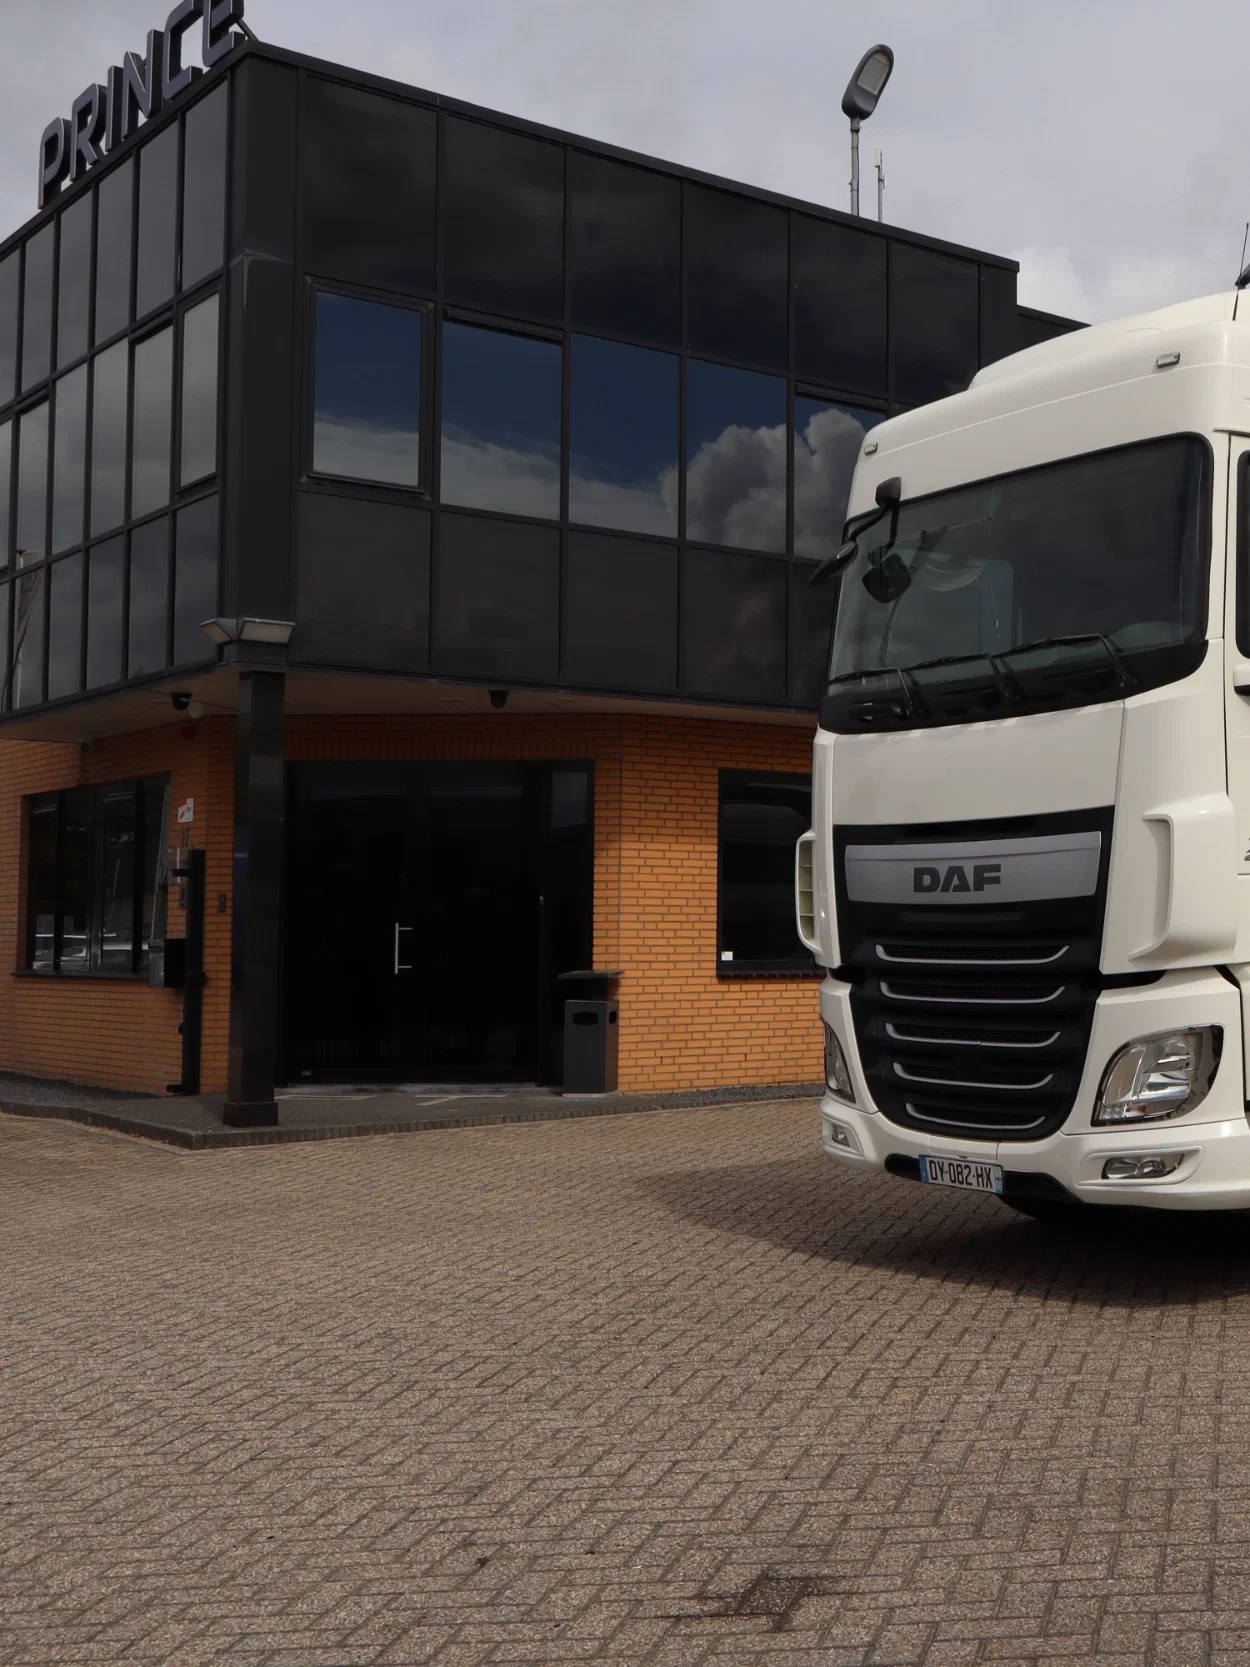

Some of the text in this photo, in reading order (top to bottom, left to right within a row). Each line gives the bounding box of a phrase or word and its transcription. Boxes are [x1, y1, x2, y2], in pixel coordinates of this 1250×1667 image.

[38, 0, 245, 210] PRINCE
[913, 864, 1001, 893] DAF
[928, 1160, 993, 1189] DY-082-HX
